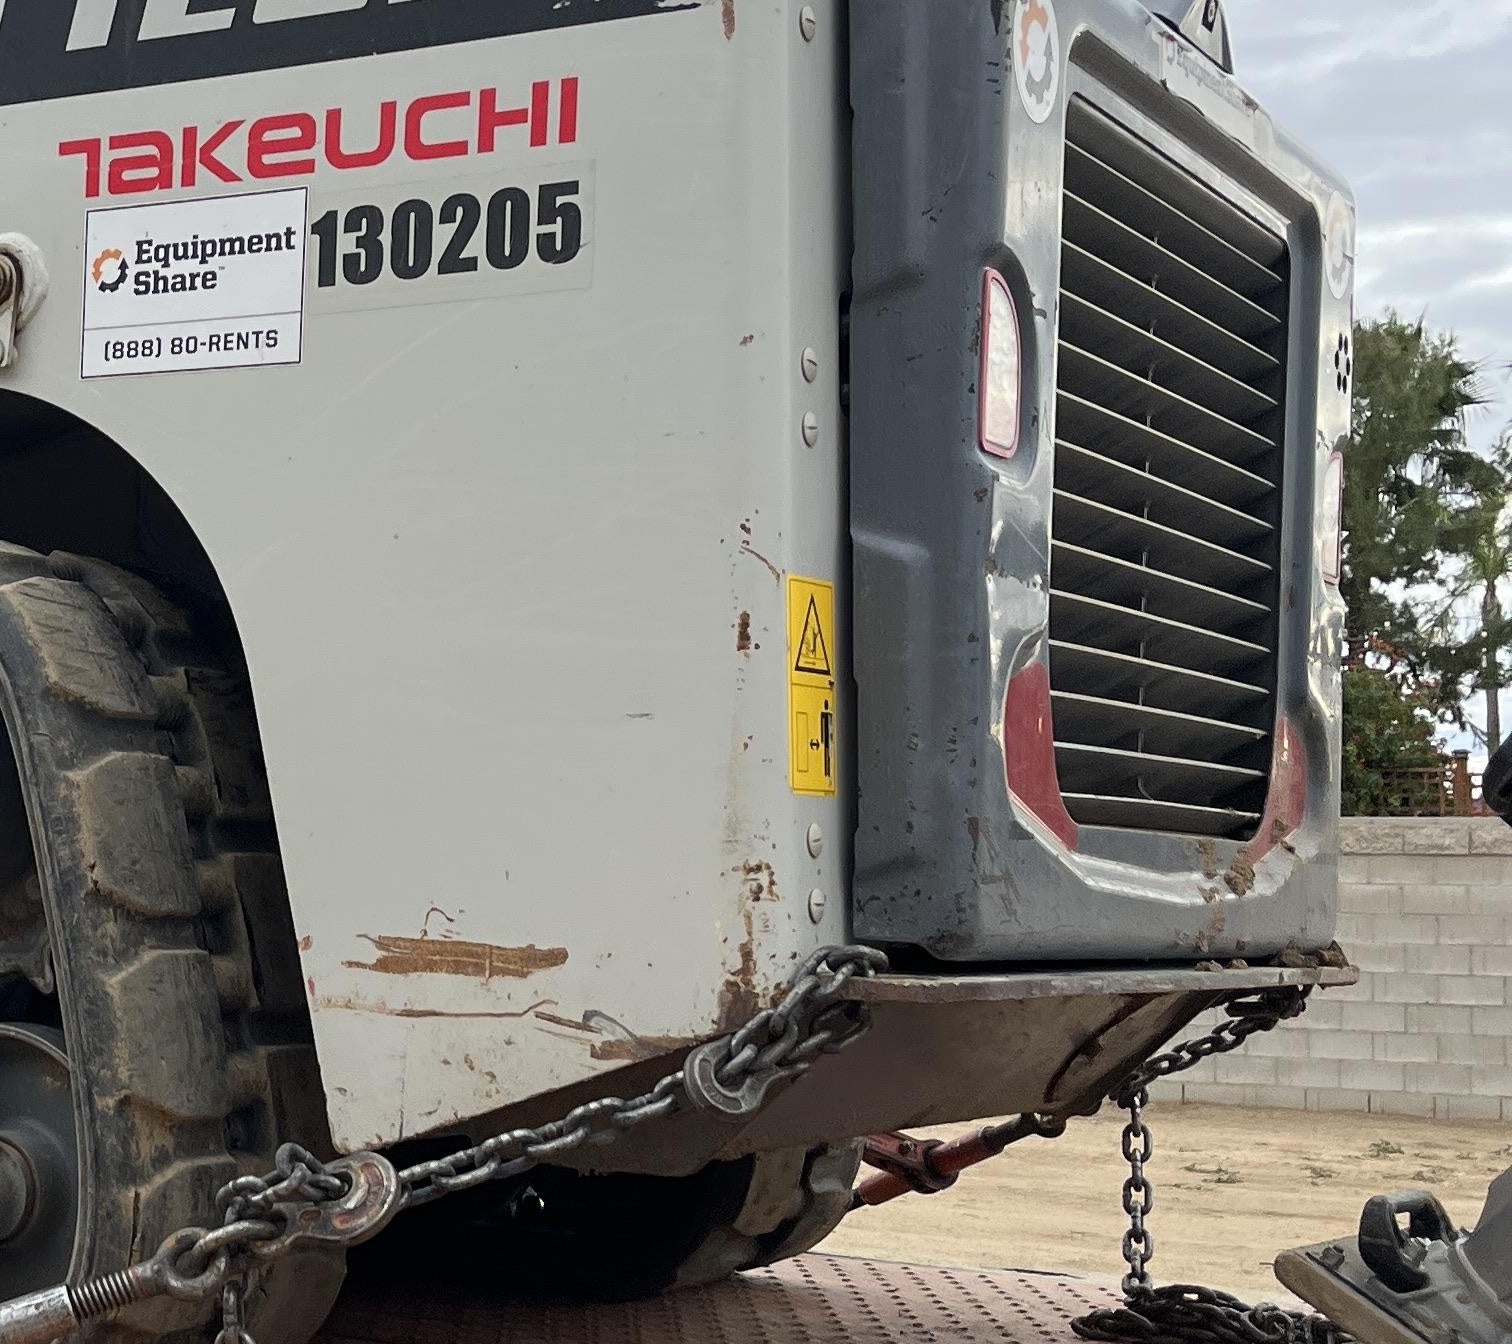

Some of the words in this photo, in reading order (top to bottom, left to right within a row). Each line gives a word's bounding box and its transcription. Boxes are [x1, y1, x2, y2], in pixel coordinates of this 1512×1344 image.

[58, 77, 580, 197] TAKEUCHI
[135, 226, 296, 268] Equipment
[310, 180, 583, 288] 130205
[133, 269, 219, 296] Share
[104, 337, 162, 361] (888)
[170, 329, 279, 355] 80-RENTS
